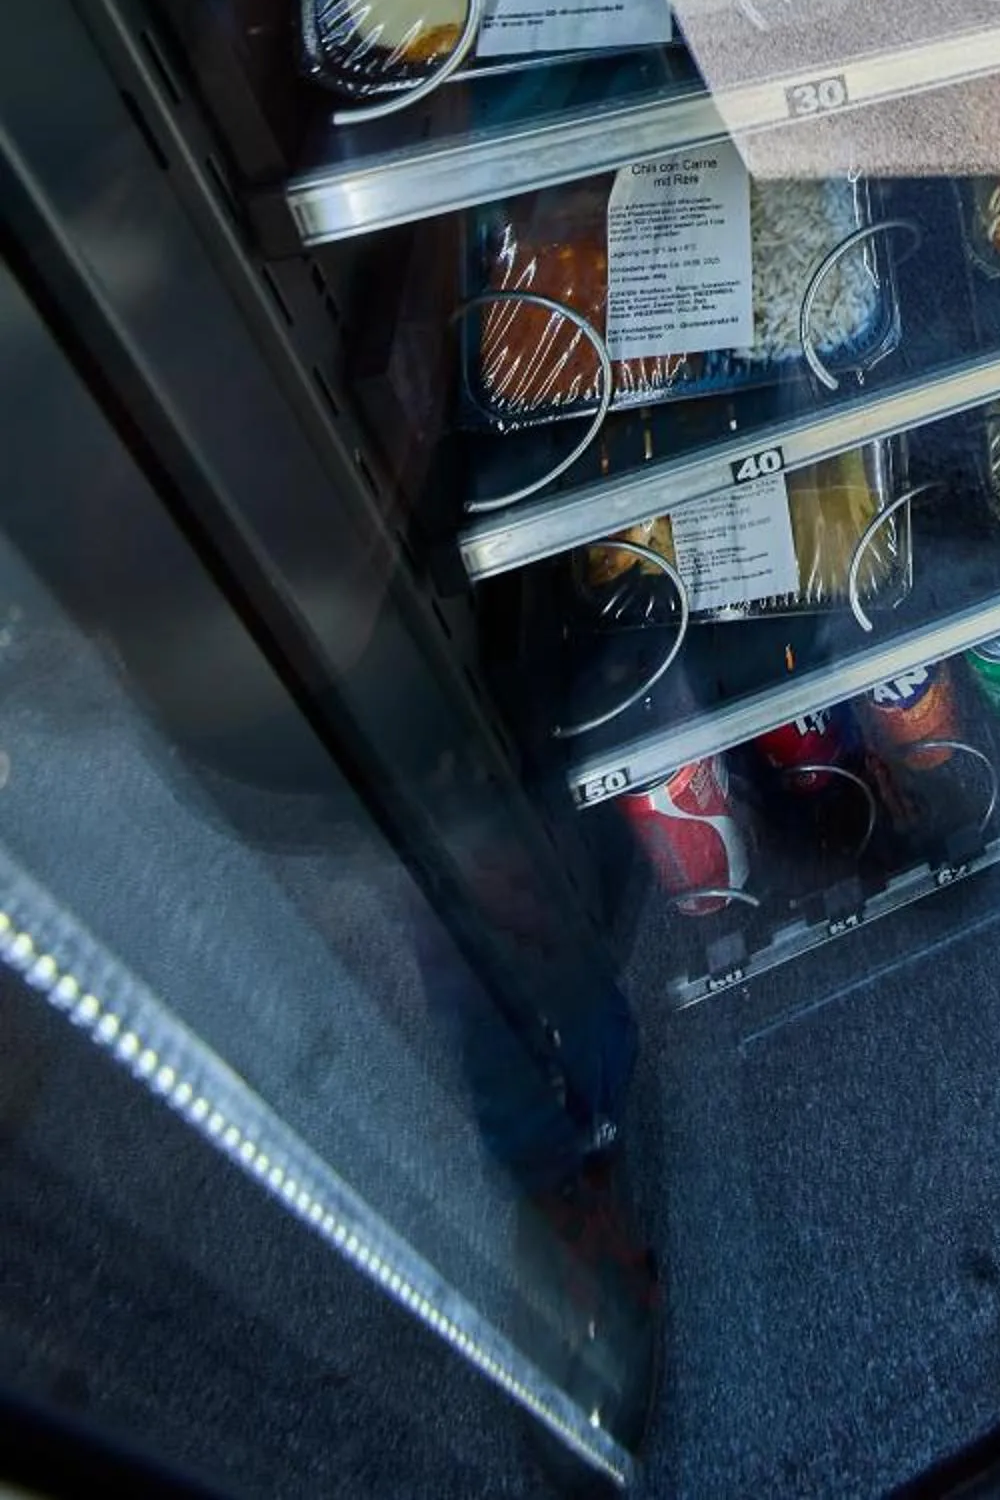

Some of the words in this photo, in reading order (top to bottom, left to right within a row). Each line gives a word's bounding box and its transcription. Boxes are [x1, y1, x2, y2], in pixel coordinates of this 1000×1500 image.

[792, 79, 844, 114] 30
[632, 162, 657, 175] Chili
[683, 158, 718, 171] Carne
[653, 175, 672, 188] mit
[673, 173, 699, 185] Reis
[736, 450, 781, 481] 40
[585, 771, 627, 800] 50
